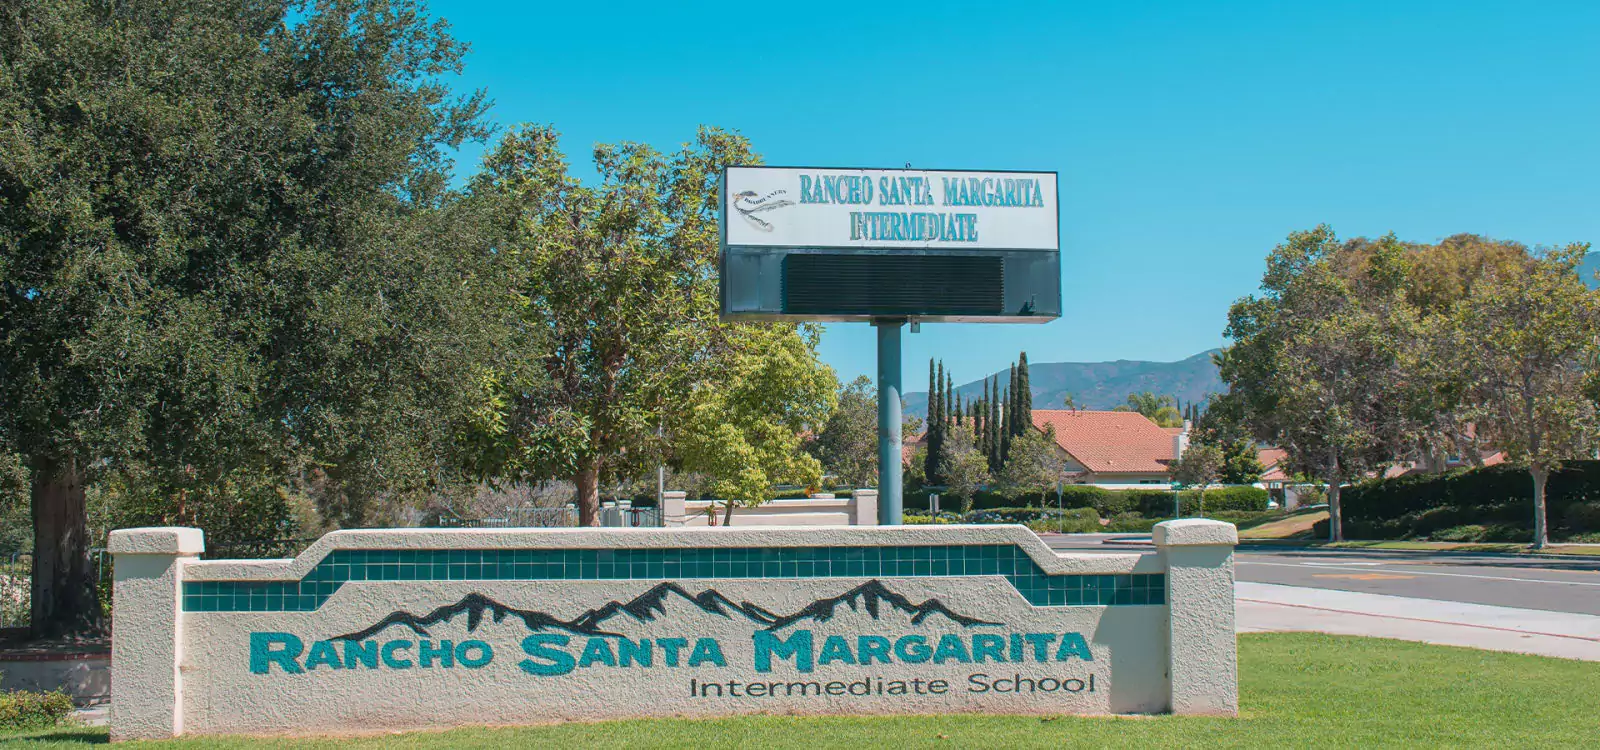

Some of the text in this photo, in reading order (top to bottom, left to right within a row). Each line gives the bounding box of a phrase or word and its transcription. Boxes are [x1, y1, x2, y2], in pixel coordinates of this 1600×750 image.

[799, 174, 1044, 207] RANCHO SANTA MARGARITA
[849, 211, 979, 242] INTERMEDIATE
[250, 628, 1093, 676] RANCHO SANTA MARGARITA
[690, 673, 1096, 698] Intermediate School
